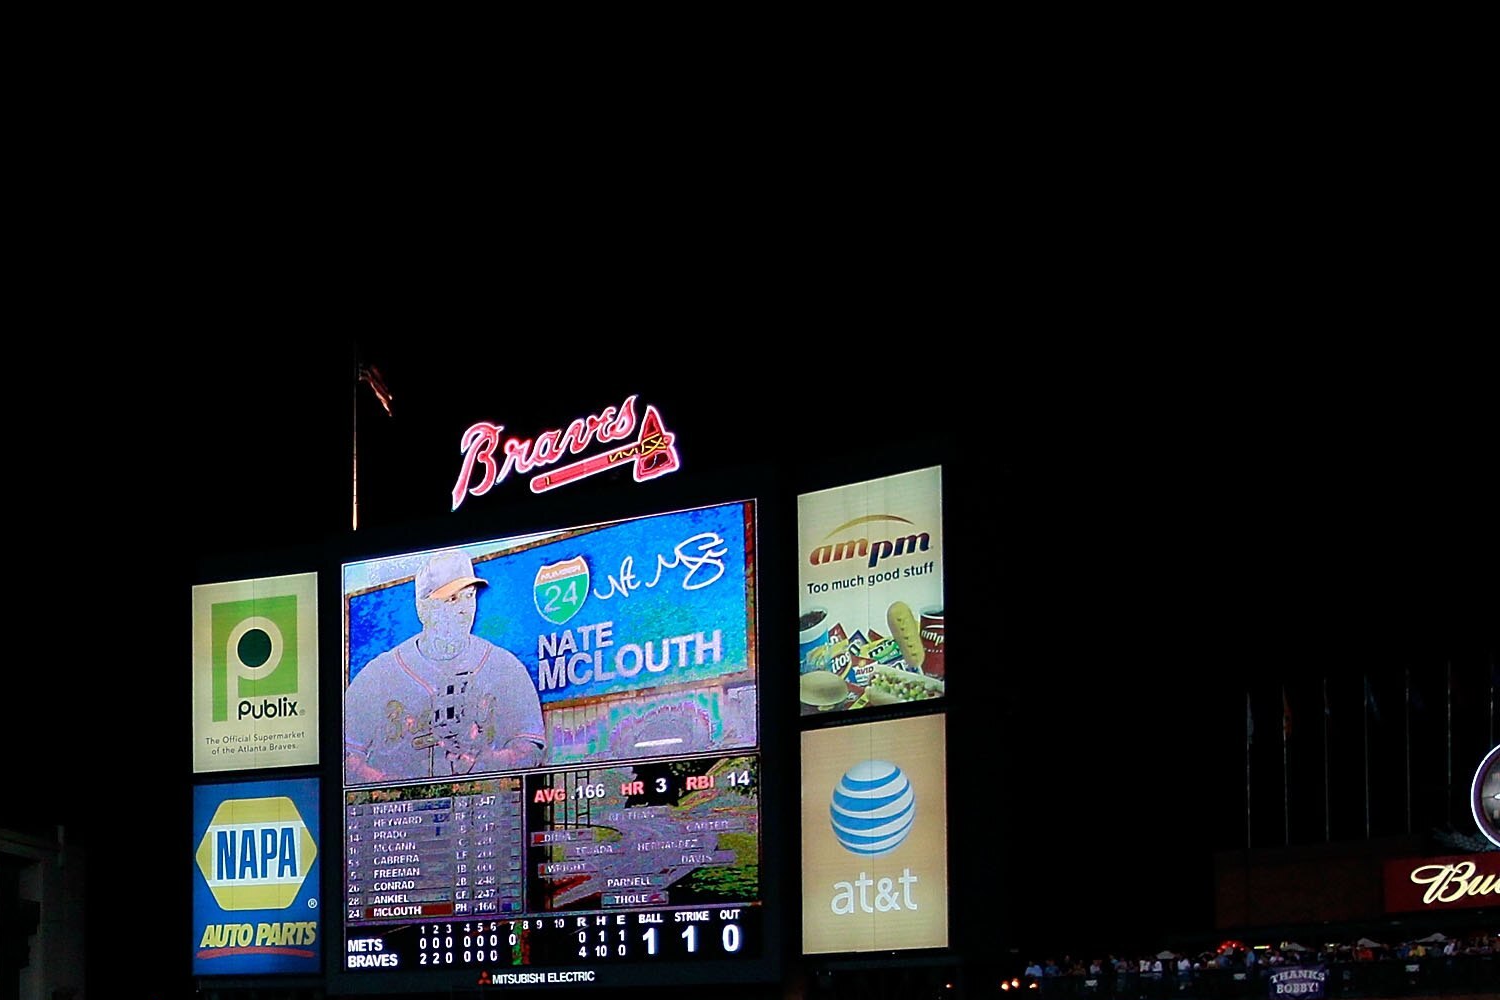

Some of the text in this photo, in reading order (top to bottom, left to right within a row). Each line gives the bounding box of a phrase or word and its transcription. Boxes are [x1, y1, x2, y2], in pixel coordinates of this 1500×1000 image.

[451, 395, 639, 512] Braves
[809, 532, 931, 568] ampm
[807, 561, 934, 594] Too much good stuff
[544, 581, 579, 613] 24
[538, 621, 614, 659] NATE
[538, 629, 722, 691] MCLOUTH
[238, 697, 298, 720] Publix
[206, 731, 305, 745] The Official Supermarket
[211, 744, 267, 755] of the Atlanta
[534, 770, 751, 803] AVG .166 HR 3 RBI 14
[216, 827, 298, 881] NAPA
[373, 867, 421, 879] FREEMAN
[607, 876, 651, 888] PARNELL
[373, 881, 415, 891] CONRAD
[830, 868, 918, 915] at&t
[373, 894, 410, 904] ANKIEL
[373, 903, 467, 917] MCLOUTH PH
[614, 894, 649, 905] THOLE
[420, 915, 626, 934] 1 2 3 4 5 6 7 8 9 10 R H E
[638, 913, 663, 924] BALL
[674, 911, 710, 922] STRIKE
[719, 909, 740, 920] OUT
[200, 921, 317, 948] AUTO PARTS
[347, 930, 625, 953] METS 0 0 0 0 0 0 0 0 1 1
[642, 927, 656, 955] 1
[681, 925, 695, 953] 1
[722, 924, 740, 952] 0
[347, 944, 626, 968] BRAVES 2 2 0 0 0 0 4 10 0
[492, 970, 596, 985] MITSUBISHI ELECTRIC
[1269, 970, 1325, 984] THANKS
[1276, 982, 1320, 994] BOBBY!
